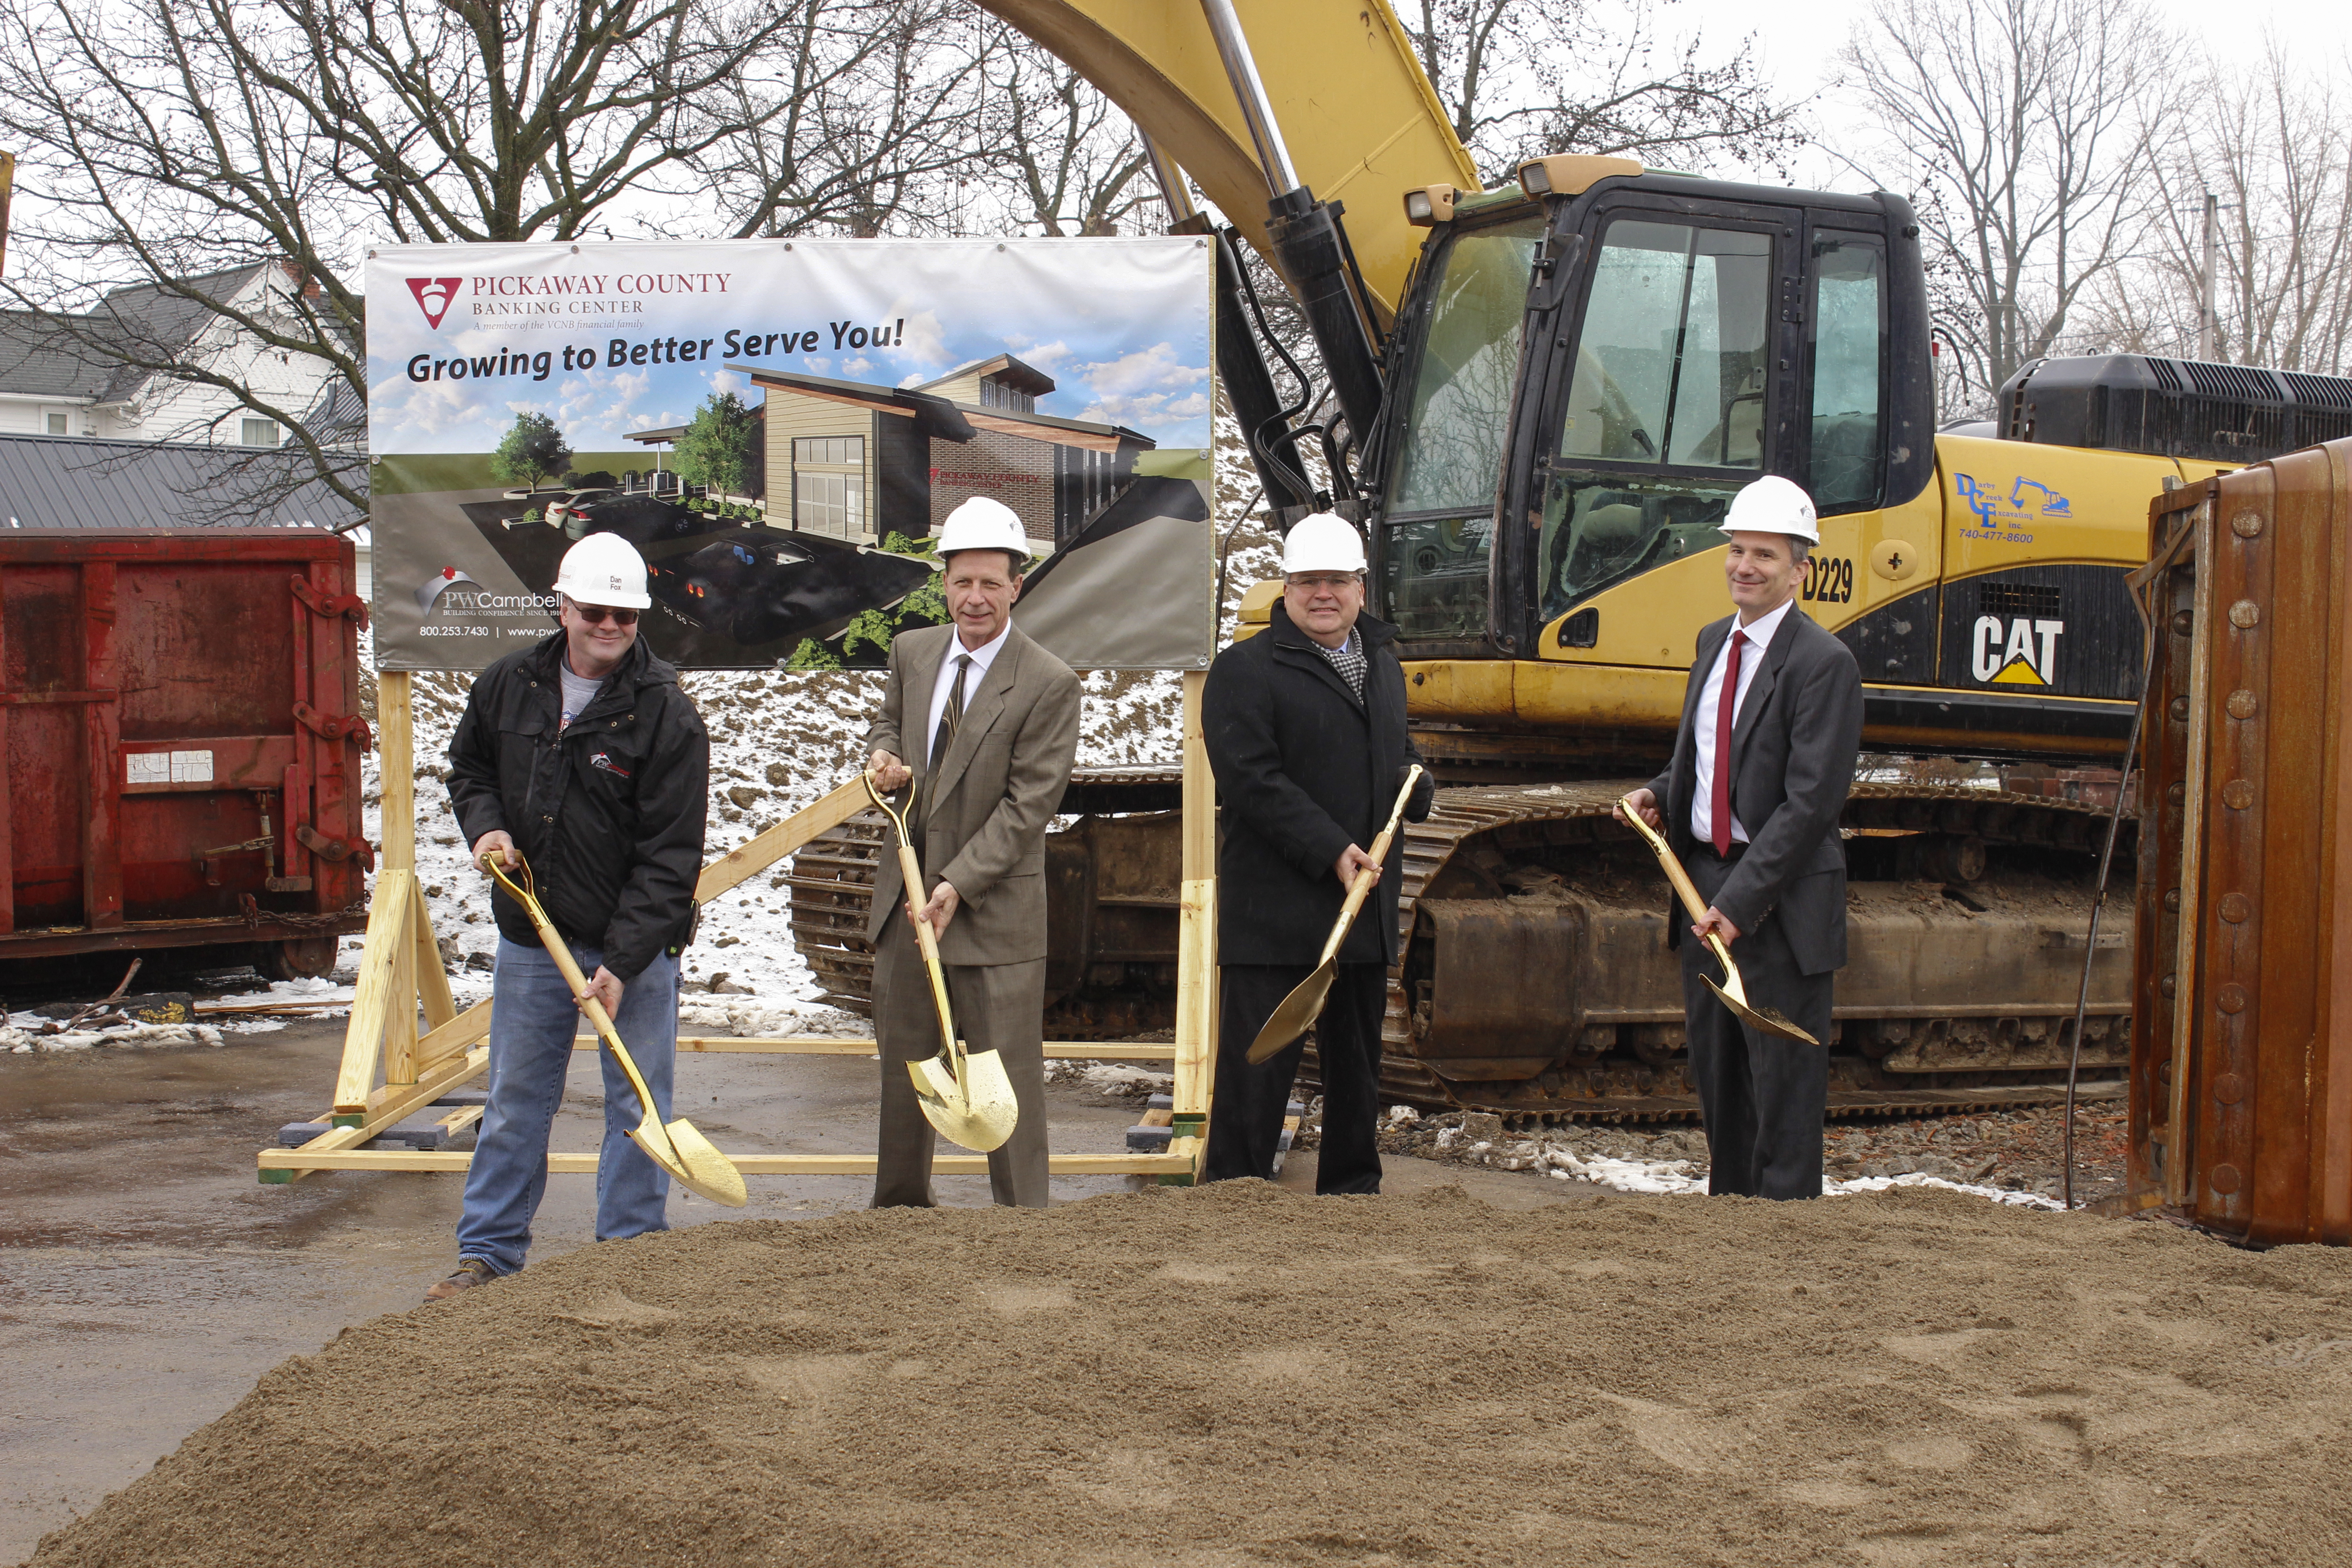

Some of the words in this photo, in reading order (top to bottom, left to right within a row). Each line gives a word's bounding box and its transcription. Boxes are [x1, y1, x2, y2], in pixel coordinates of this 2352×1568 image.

[472, 275, 608, 295] PICKAWAY
[617, 273, 731, 294] COUNTY
[472, 302, 560, 315] BANKING
[569, 301, 643, 314] CENTER
[483, 321, 518, 330] member
[519, 320, 530, 332] of
[531, 321, 544, 329] the
[547, 320, 574, 329] VCNB
[575, 319, 615, 332] financial
[615, 319, 644, 331] family
[407, 347, 552, 382] Growing
[563, 345, 597, 371] to
[607, 336, 714, 368] Better
[722, 329, 818, 358] Serve
[829, 318, 904, 350] You!
[940, 471, 989, 480] PICKAWAY
[993, 473, 1039, 483] COUNTY
[1959, 529, 2033, 544] 740-477-8600
[1803, 556, 1852, 603] D229
[443, 591, 563, 610] PWCampbell
[420, 627, 489, 636] 800.253.7430
[1972, 616, 2063, 686] CAT
